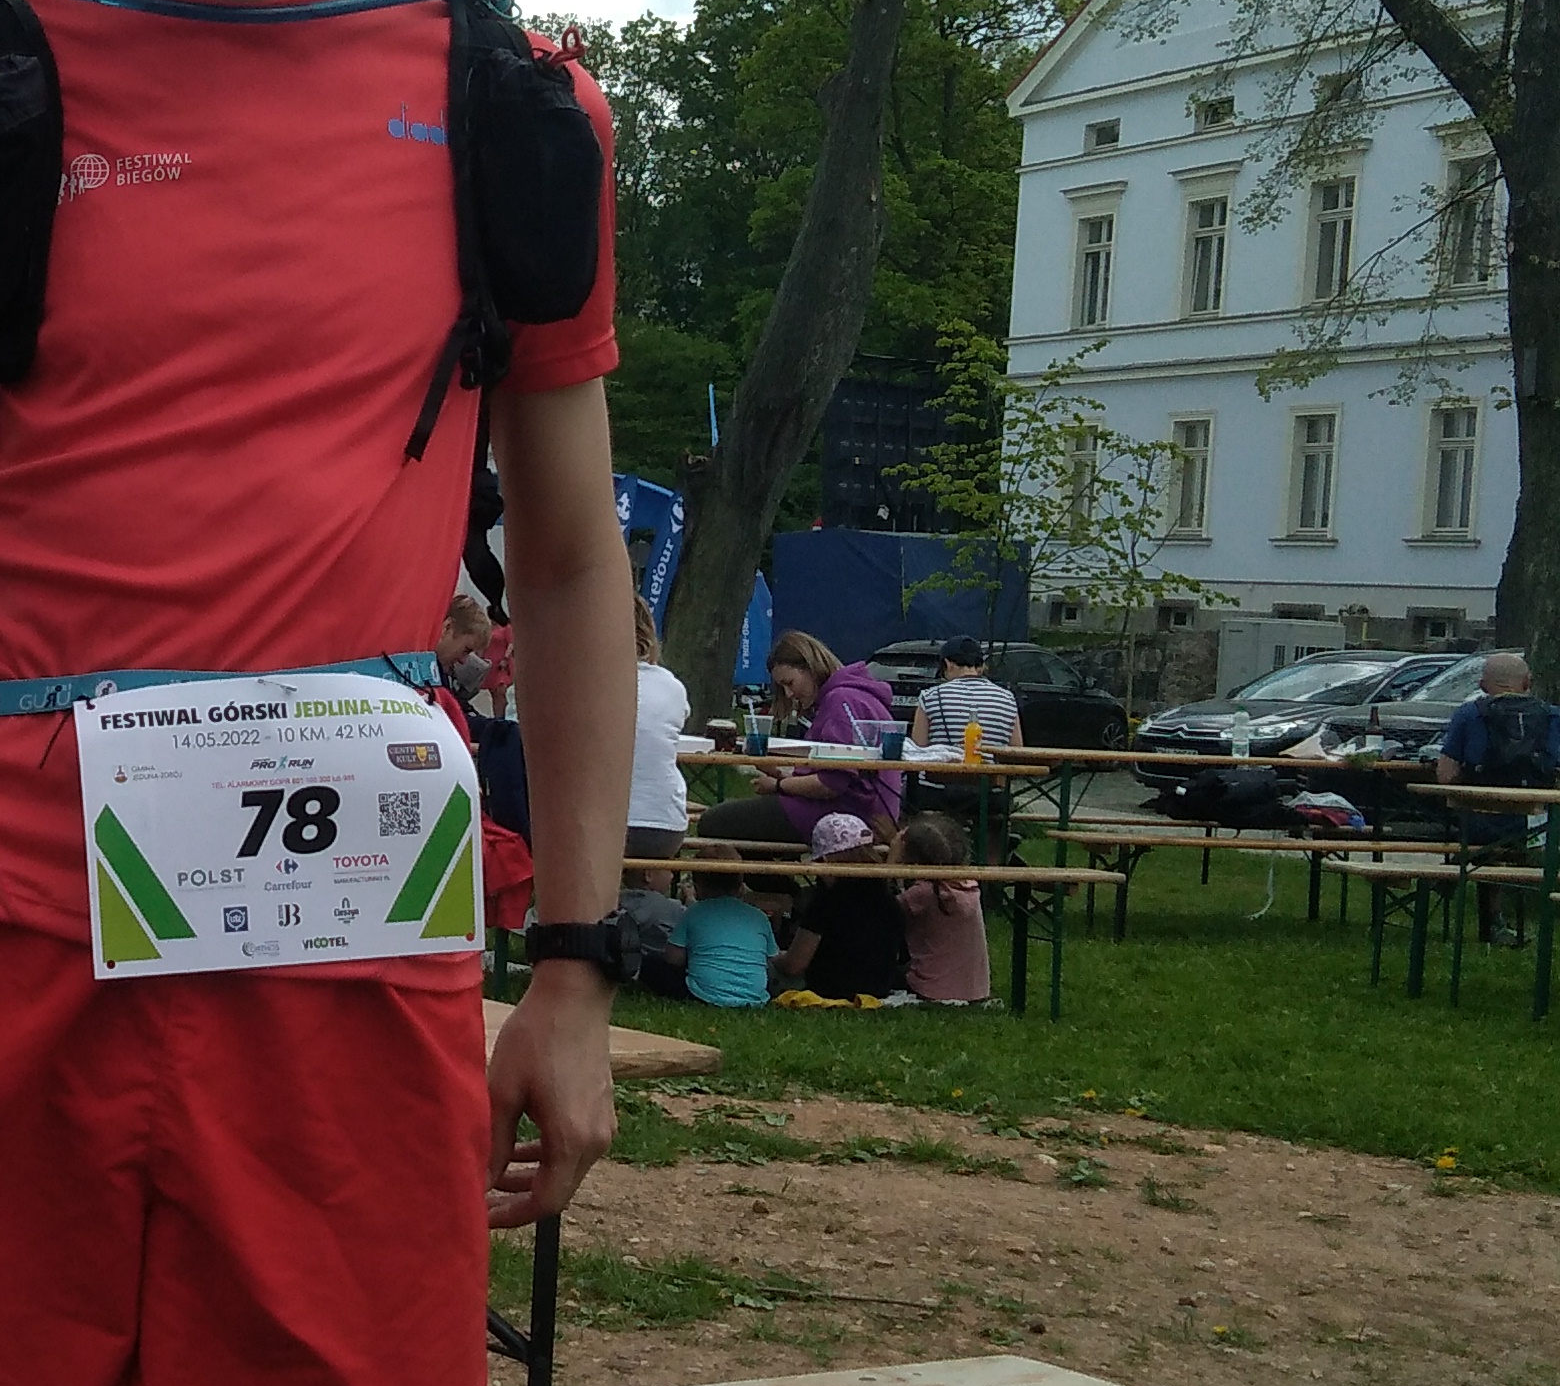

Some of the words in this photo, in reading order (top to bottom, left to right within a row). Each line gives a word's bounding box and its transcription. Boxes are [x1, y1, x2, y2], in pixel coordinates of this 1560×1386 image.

[116, 153, 192, 172] FESTIWAL
[116, 166, 181, 186] BIEGÓW
[100, 707, 202, 730] FESTIWAL
[208, 700, 288, 723] GÓRSKI
[294, 699, 433, 720] JEDLINA-ZDRÓJ
[172, 729, 261, 749] 14.05.2022
[276, 727, 295, 743] 10
[335, 724, 354, 739] 42
[358, 723, 384, 738] KM
[250, 759, 277, 770] PRO
[288, 758, 315, 768] RUN
[236, 785, 341, 858] 78
[332, 853, 390, 869] TOYOTA
[177, 868, 246, 887] POLST
[264, 880, 313, 892] Carrefour
[302, 936, 349, 951] VICOTEL
